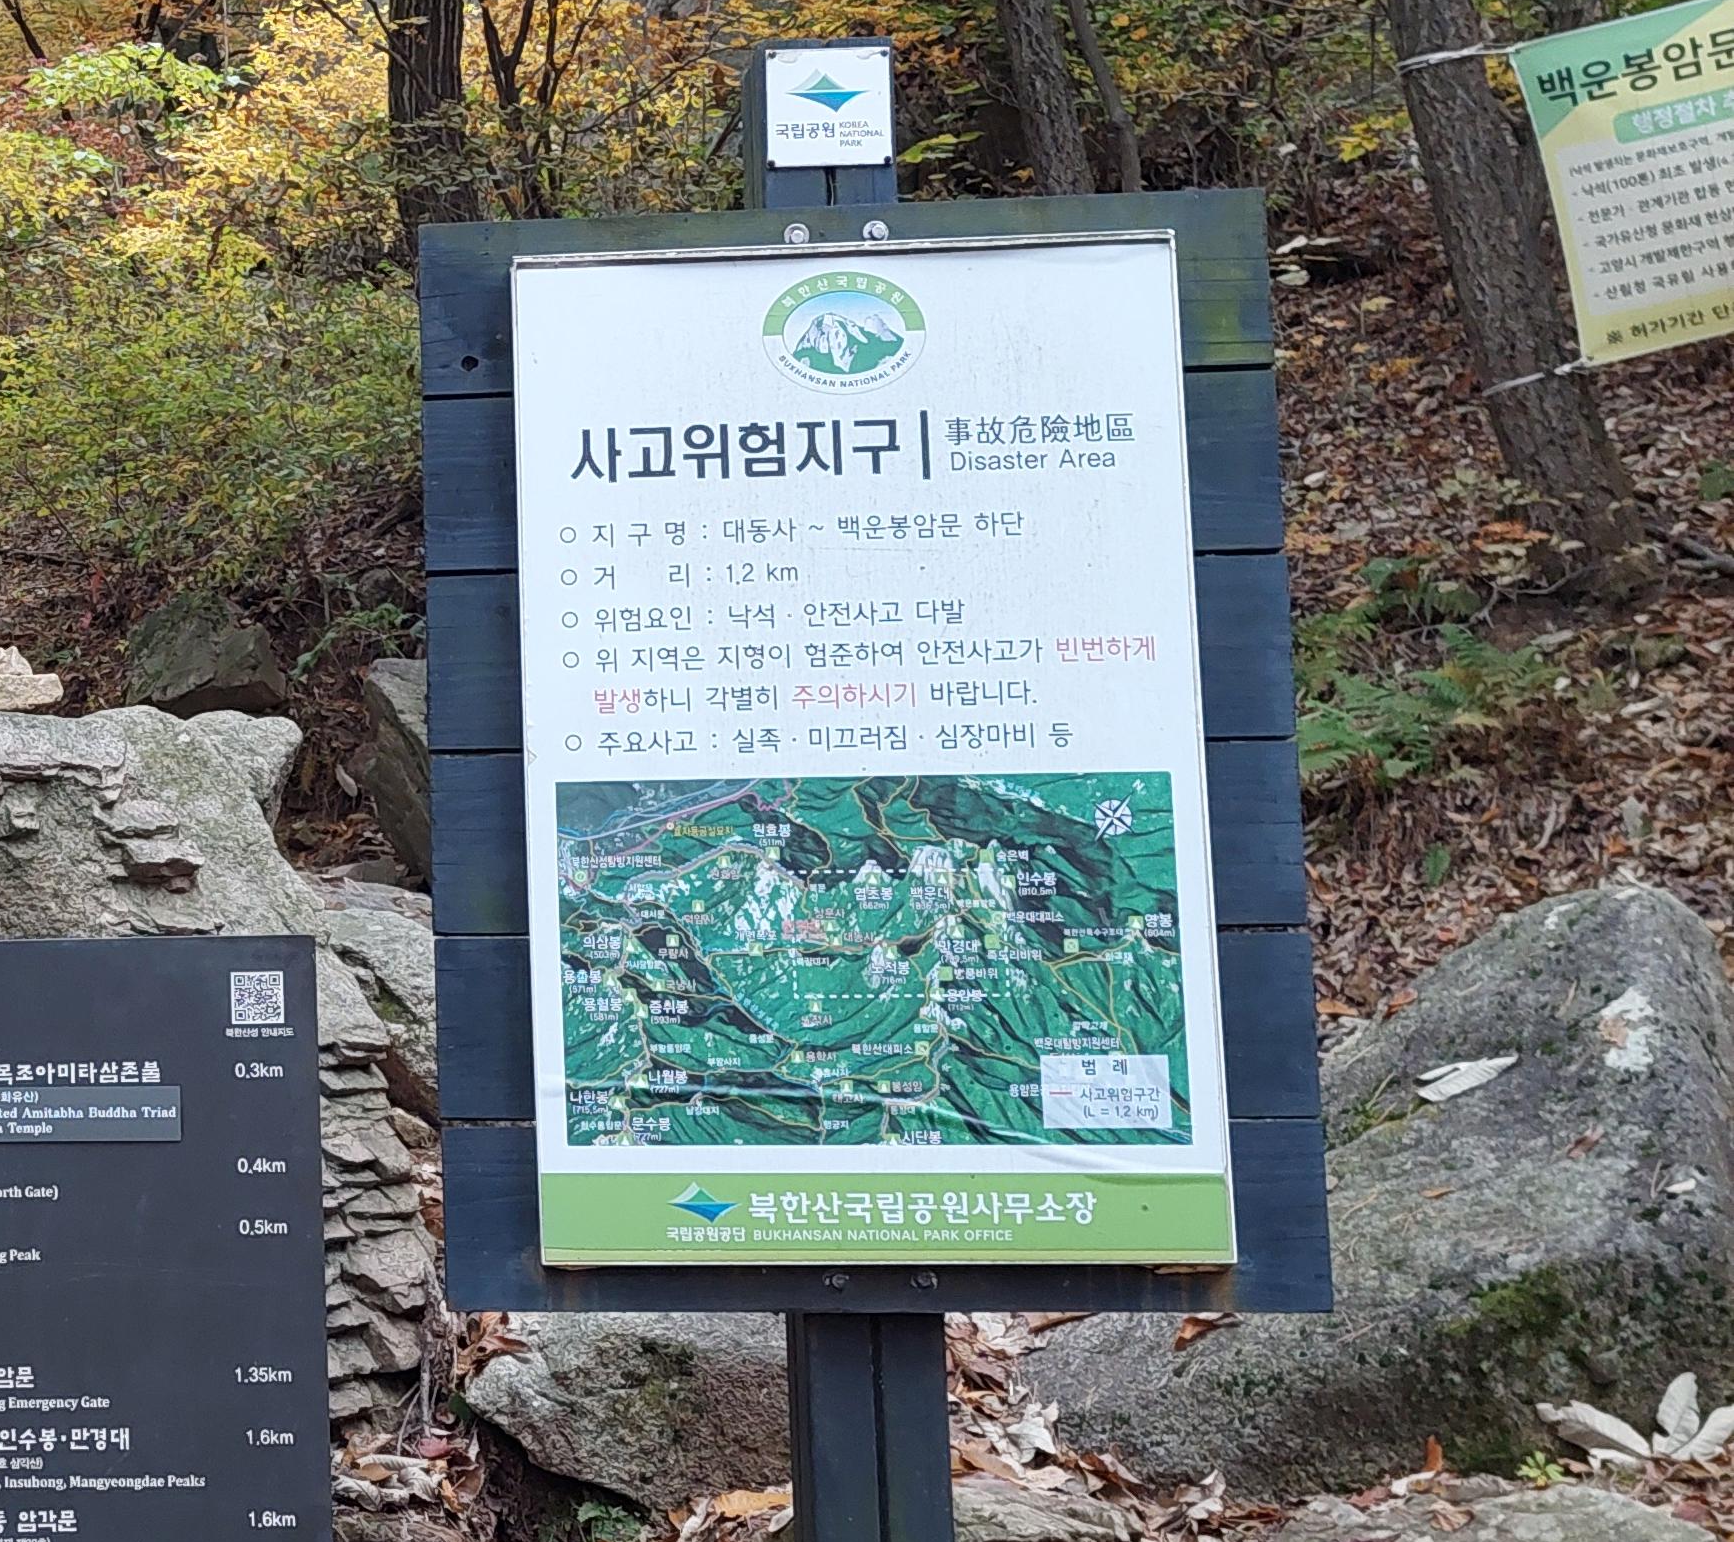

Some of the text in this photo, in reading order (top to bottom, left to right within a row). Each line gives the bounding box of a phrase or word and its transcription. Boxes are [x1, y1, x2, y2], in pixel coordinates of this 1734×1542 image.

[776, 122, 835, 139] 국립공원
[840, 139, 863, 147] PARK
[840, 371, 890, 388] NATIONAL
[891, 351, 911, 372] PARK
[944, 413, 1136, 445] 事故危險地區
[570, 417, 902, 484] 사고위험지구
[950, 447, 1116, 472] Disaster Area
[722, 518, 796, 545] 대동사
[837, 513, 960, 540] 백운봉암문
[974, 512, 1023, 536] 하단
[594, 599, 965, 633] 위험요인 낙석 안전사고 다발
[594, 635, 1156, 673] 위 지역은 지형이 험준하여 안전사고가 빈번하게
[593, 680, 1038, 714] 발생하니 각별히 주의하시기 바랍니다.
[597, 722, 1073, 756] 주요사고 실족 미끄러짐 심장마비 등
[1016, 872, 1057, 886] 인수봉
[235, 1063, 283, 1078] 0.3km
[1080, 1087, 1160, 1102] 사고위험구간
[22, 1107, 84, 1118] Amitabha
[89, 1107, 136, 1118] Buddha
[141, 1107, 175, 1118] Triad
[7, 1123, 52, 1135] Temple
[238, 1158, 286, 1174] 0.4km
[25, 1186, 59, 1200] Gate)
[749, 1191, 1096, 1226] 북한산국립공원사무소장
[239, 1219, 287, 1235] 0.5km
[666, 1226, 746, 1242] 국립공원공단
[753, 1229, 1012, 1241] BUKHANSAN NATIONAL PARK OFFICE
[10, 1249, 40, 1261] Peak
[234, 1367, 292, 1384] 1.35km
[9, 1397, 79, 1411] Emergency
[81, 1396, 110, 1408] Gate
[246, 1431, 294, 1446] 1.6km
[5, 1476, 66, 1490] Insubong,
[70, 1476, 164, 1490] Mangyeongdae
[168, 1475, 205, 1486] Peaks
[18, 1510, 77, 1532] 암각문
[248, 1512, 296, 1528] 1.6km
